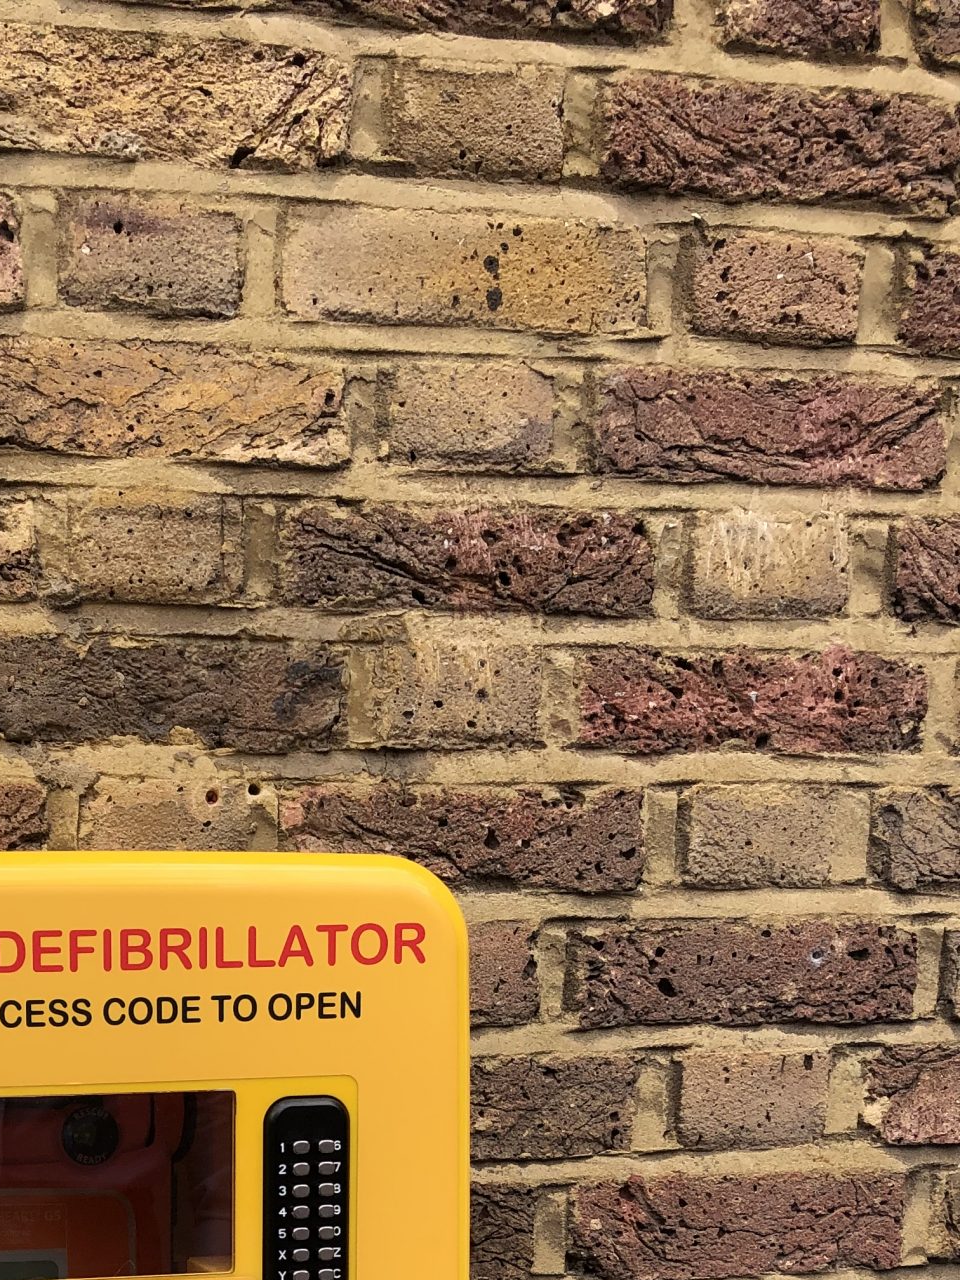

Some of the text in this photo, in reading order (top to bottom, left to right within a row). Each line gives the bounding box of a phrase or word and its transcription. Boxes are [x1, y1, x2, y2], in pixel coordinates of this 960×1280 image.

[102, 995, 202, 1026] CODE
[210, 993, 258, 1023] TO
[267, 990, 362, 1022] OPEN
[280, 1140, 342, 1153] 1 6
[278, 1161, 342, 1175] 2 7
[278, 1183, 342, 1197] 3 8
[278, 1204, 342, 1218] 4 9
[278, 1228, 287, 1239] 5
[278, 1247, 342, 1261] X Z
[333, 1268, 342, 1279] C
